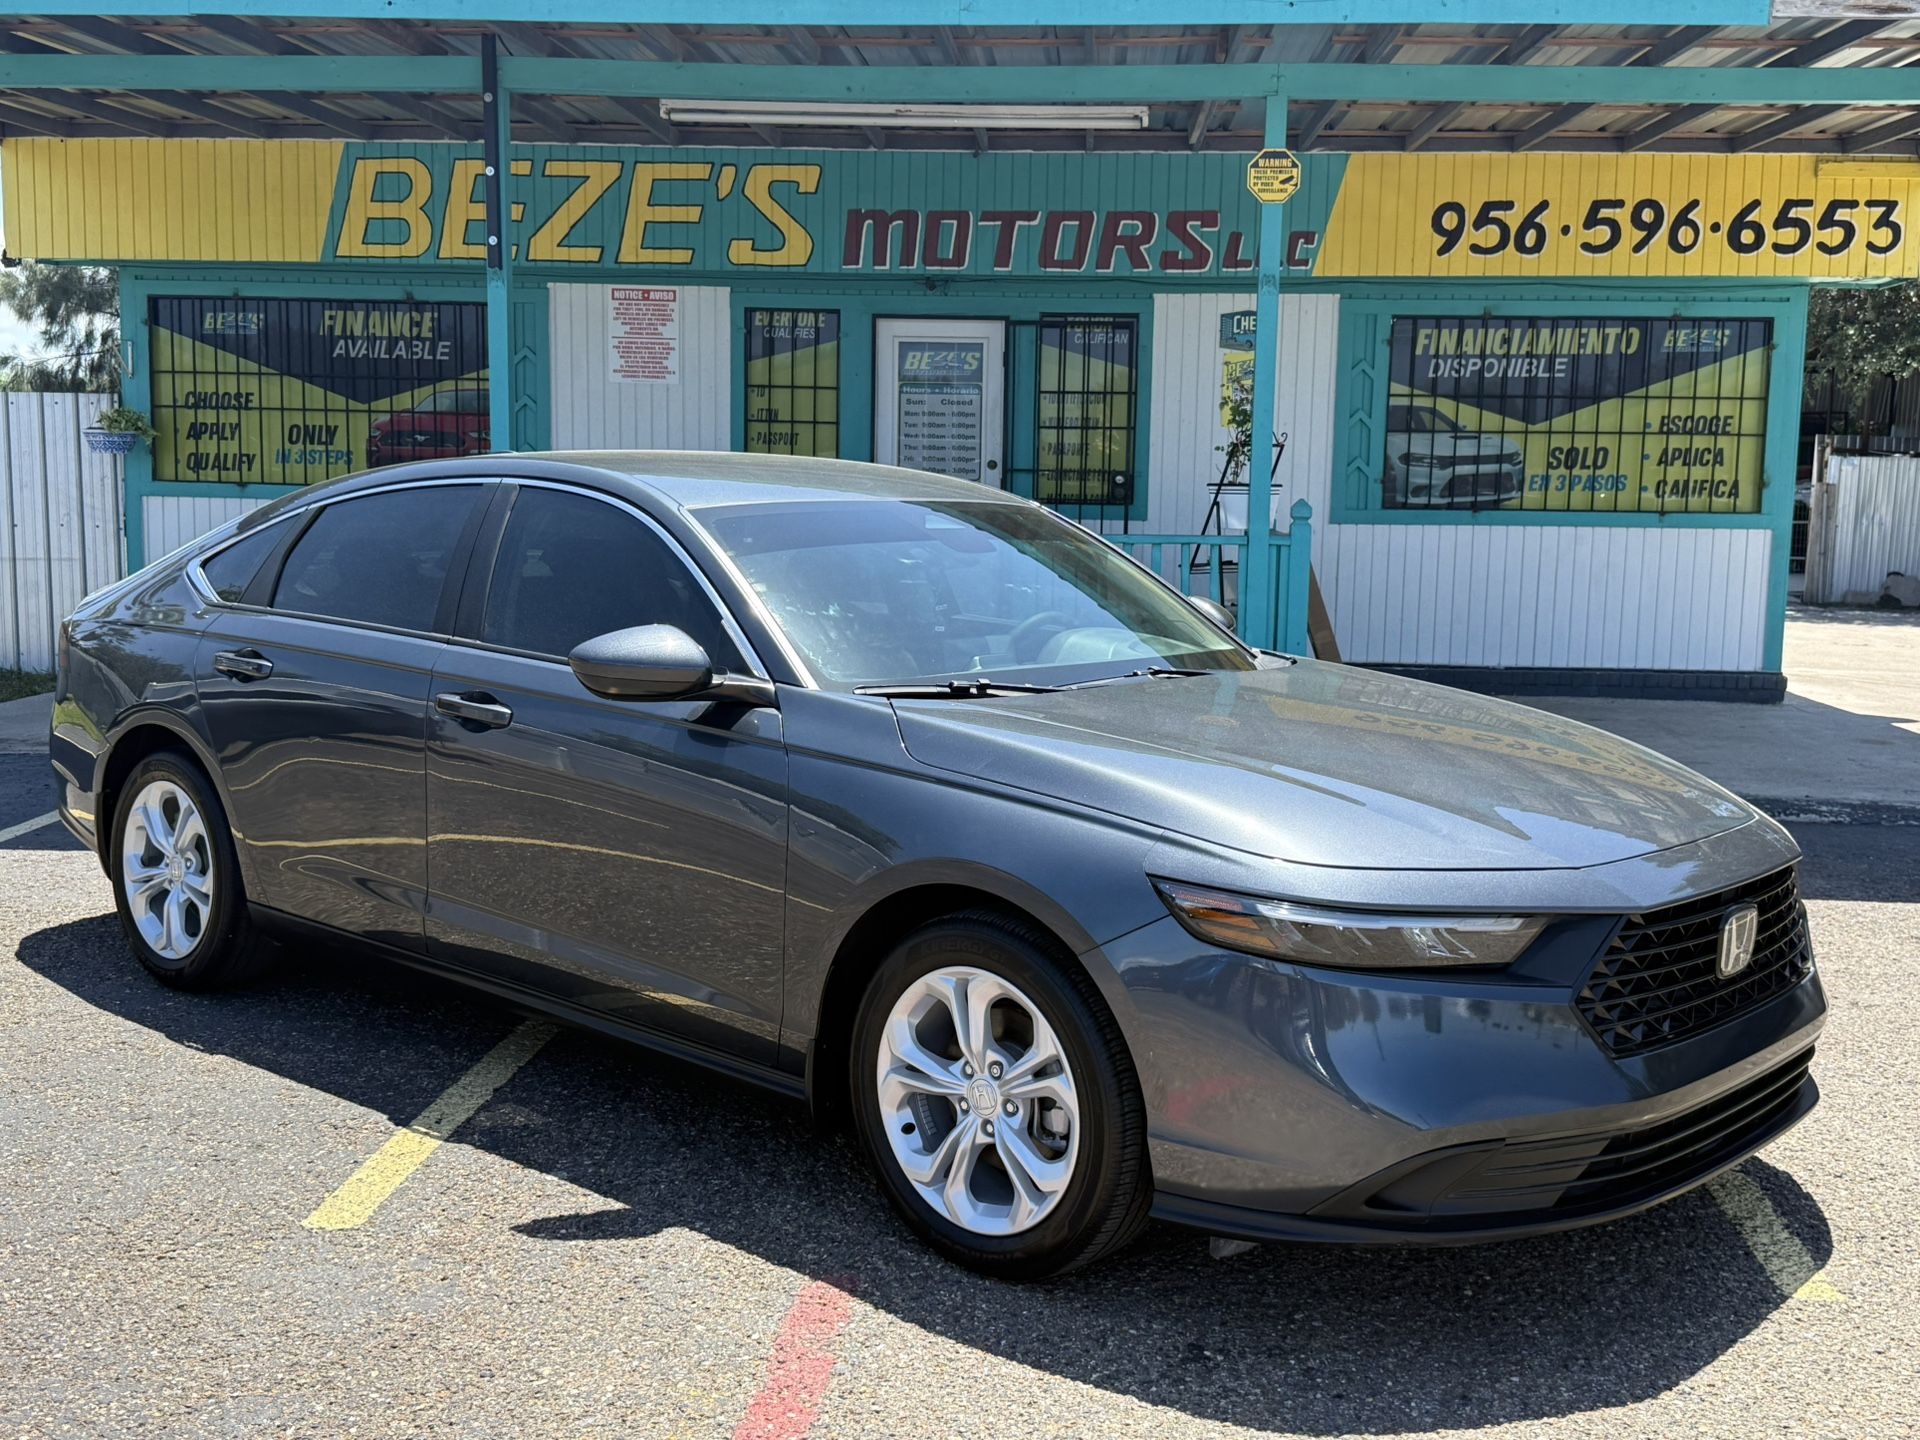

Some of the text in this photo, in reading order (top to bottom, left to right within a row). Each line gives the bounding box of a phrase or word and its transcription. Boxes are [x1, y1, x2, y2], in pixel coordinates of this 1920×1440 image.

[1258, 158, 1292, 168] WARNING
[336, 156, 822, 267] BEZE'S
[842, 208, 1318, 273] MOTORS LC
[613, 290, 674, 300] NOTICE AVISO
[319, 310, 438, 337] FINANCE
[754, 311, 826, 327] EVERYONE
[332, 339, 451, 360] AVAILABLE
[1415, 326, 1640, 355] FINANCIAMIENTO
[904, 352, 980, 370] BEZE'S
[1428, 358, 1568, 378] DISPONIBLE
[185, 391, 254, 410] CHOOSE
[186, 422, 241, 440] APPLY
[288, 424, 338, 445] ONLY
[1659, 416, 1733, 435] ESCOGE
[186, 452, 256, 472] QUALIFY
[275, 449, 290, 464] IN
[306, 451, 353, 465] STEPS
[1548, 447, 1609, 470] SOLO
[1656, 448, 1724, 467] APLICA
[1528, 475, 1627, 492] EN 3 PASOS
